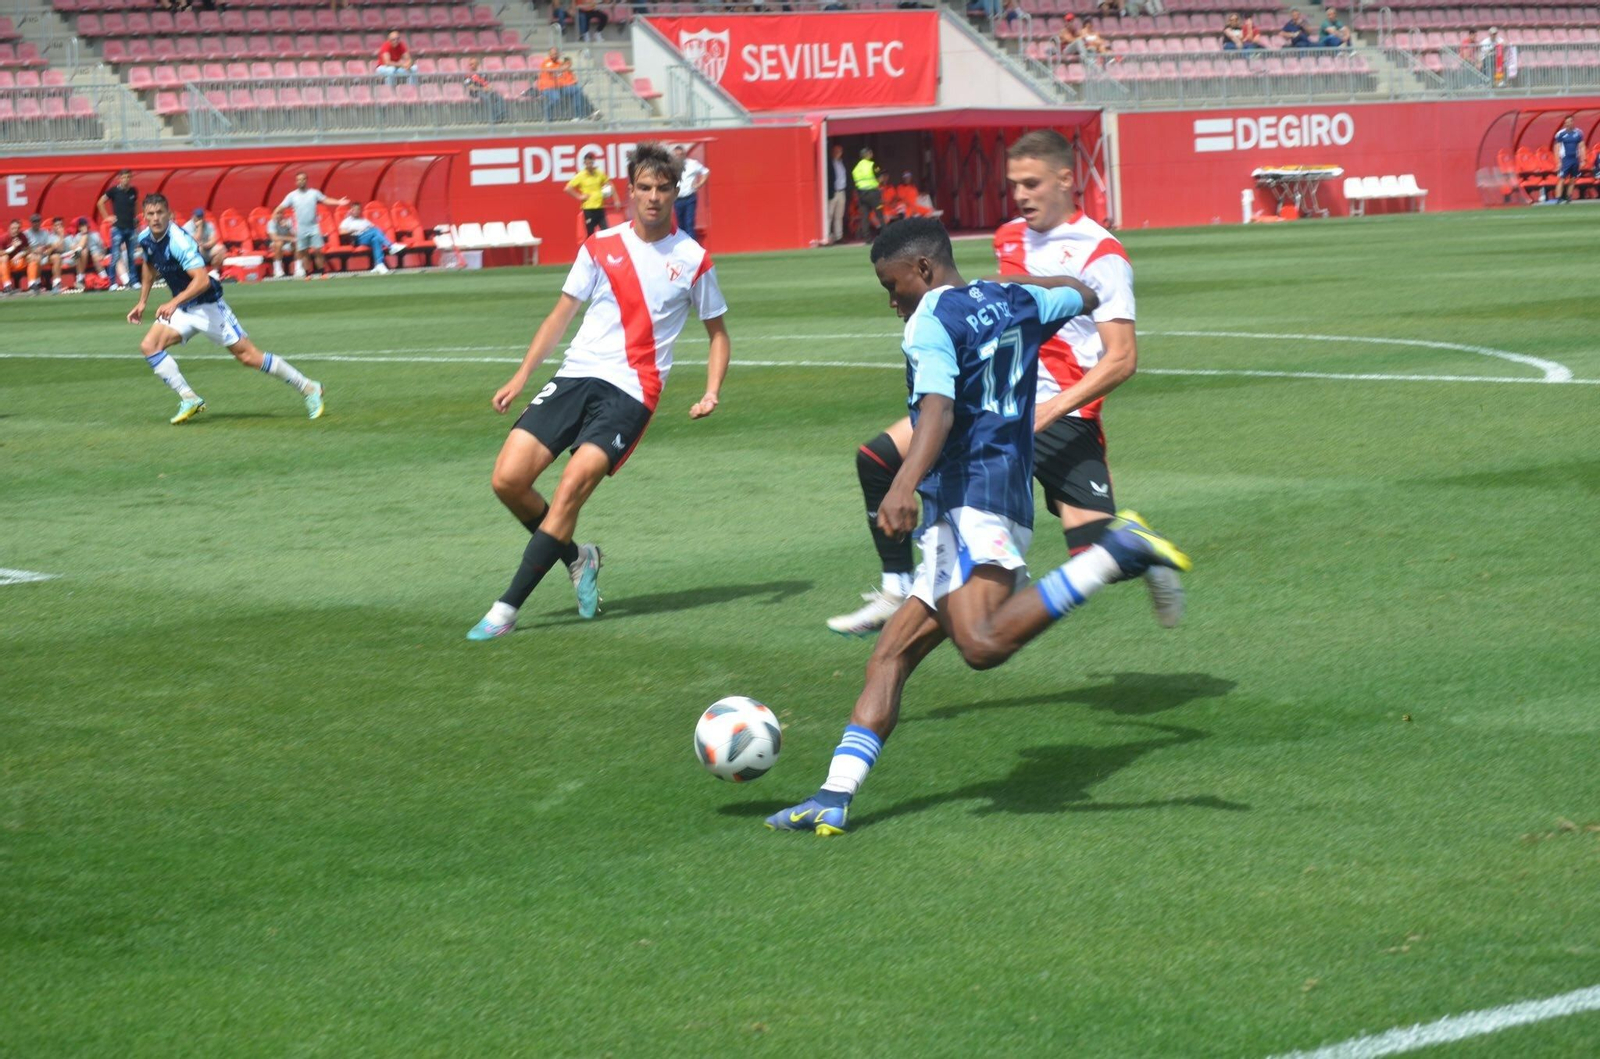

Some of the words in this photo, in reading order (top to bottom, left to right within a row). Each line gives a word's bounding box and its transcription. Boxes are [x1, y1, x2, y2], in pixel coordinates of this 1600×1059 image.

[741, 42, 860, 82] SEVILLA
[866, 40, 905, 78] FC
[1235, 112, 1355, 151] DEGIRO
[6, 174, 29, 207] E
